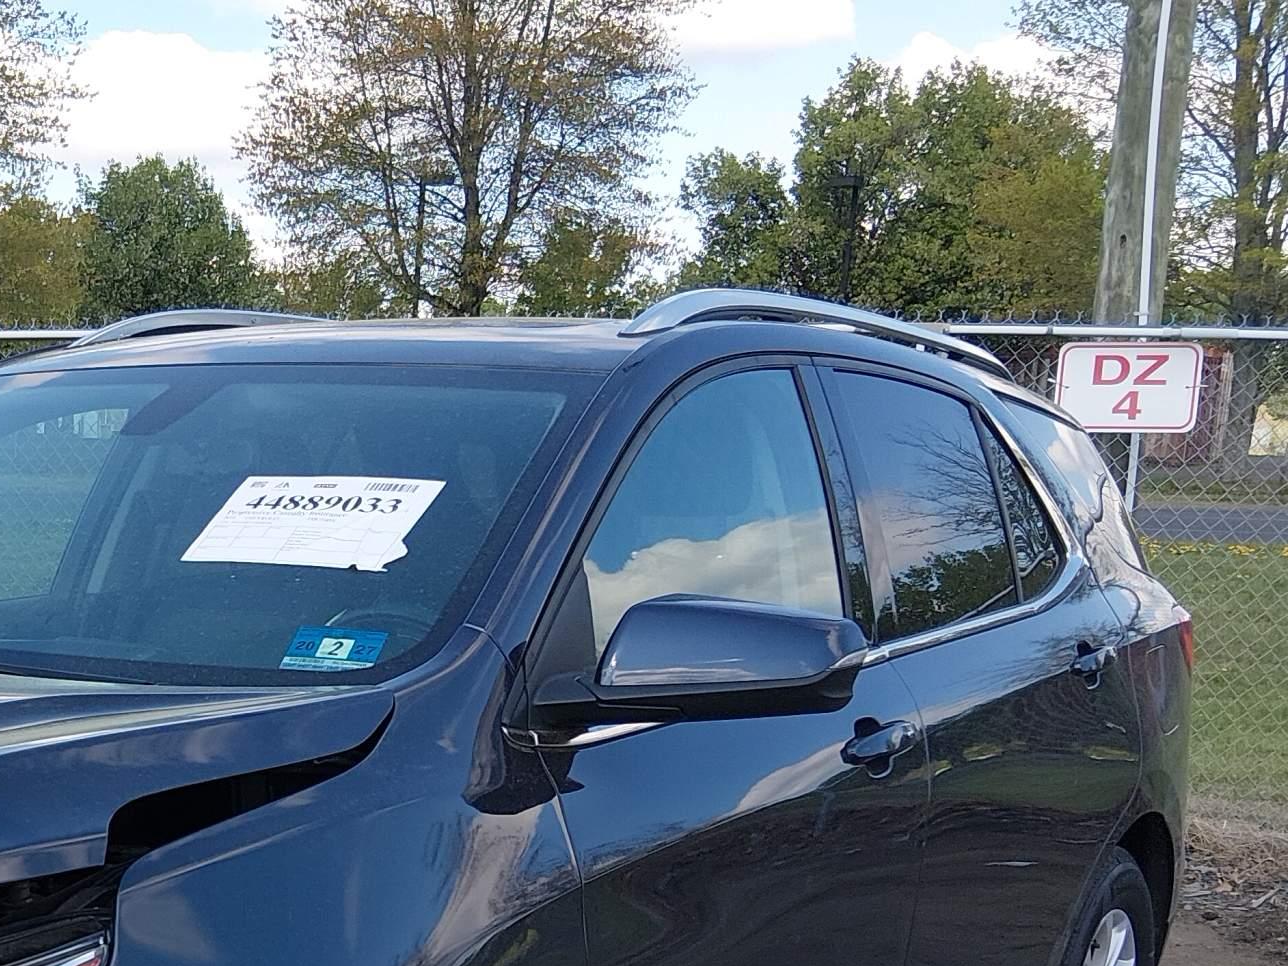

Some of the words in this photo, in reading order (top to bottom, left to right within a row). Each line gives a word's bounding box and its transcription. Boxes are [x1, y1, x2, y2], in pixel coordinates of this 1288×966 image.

[1092, 354, 1170, 385] DZ
[1112, 391, 1142, 420] 4
[245, 494, 403, 514] 44889033
[295, 640, 315, 651] 20
[327, 641, 344, 656] 2
[353, 644, 376, 656] 27
